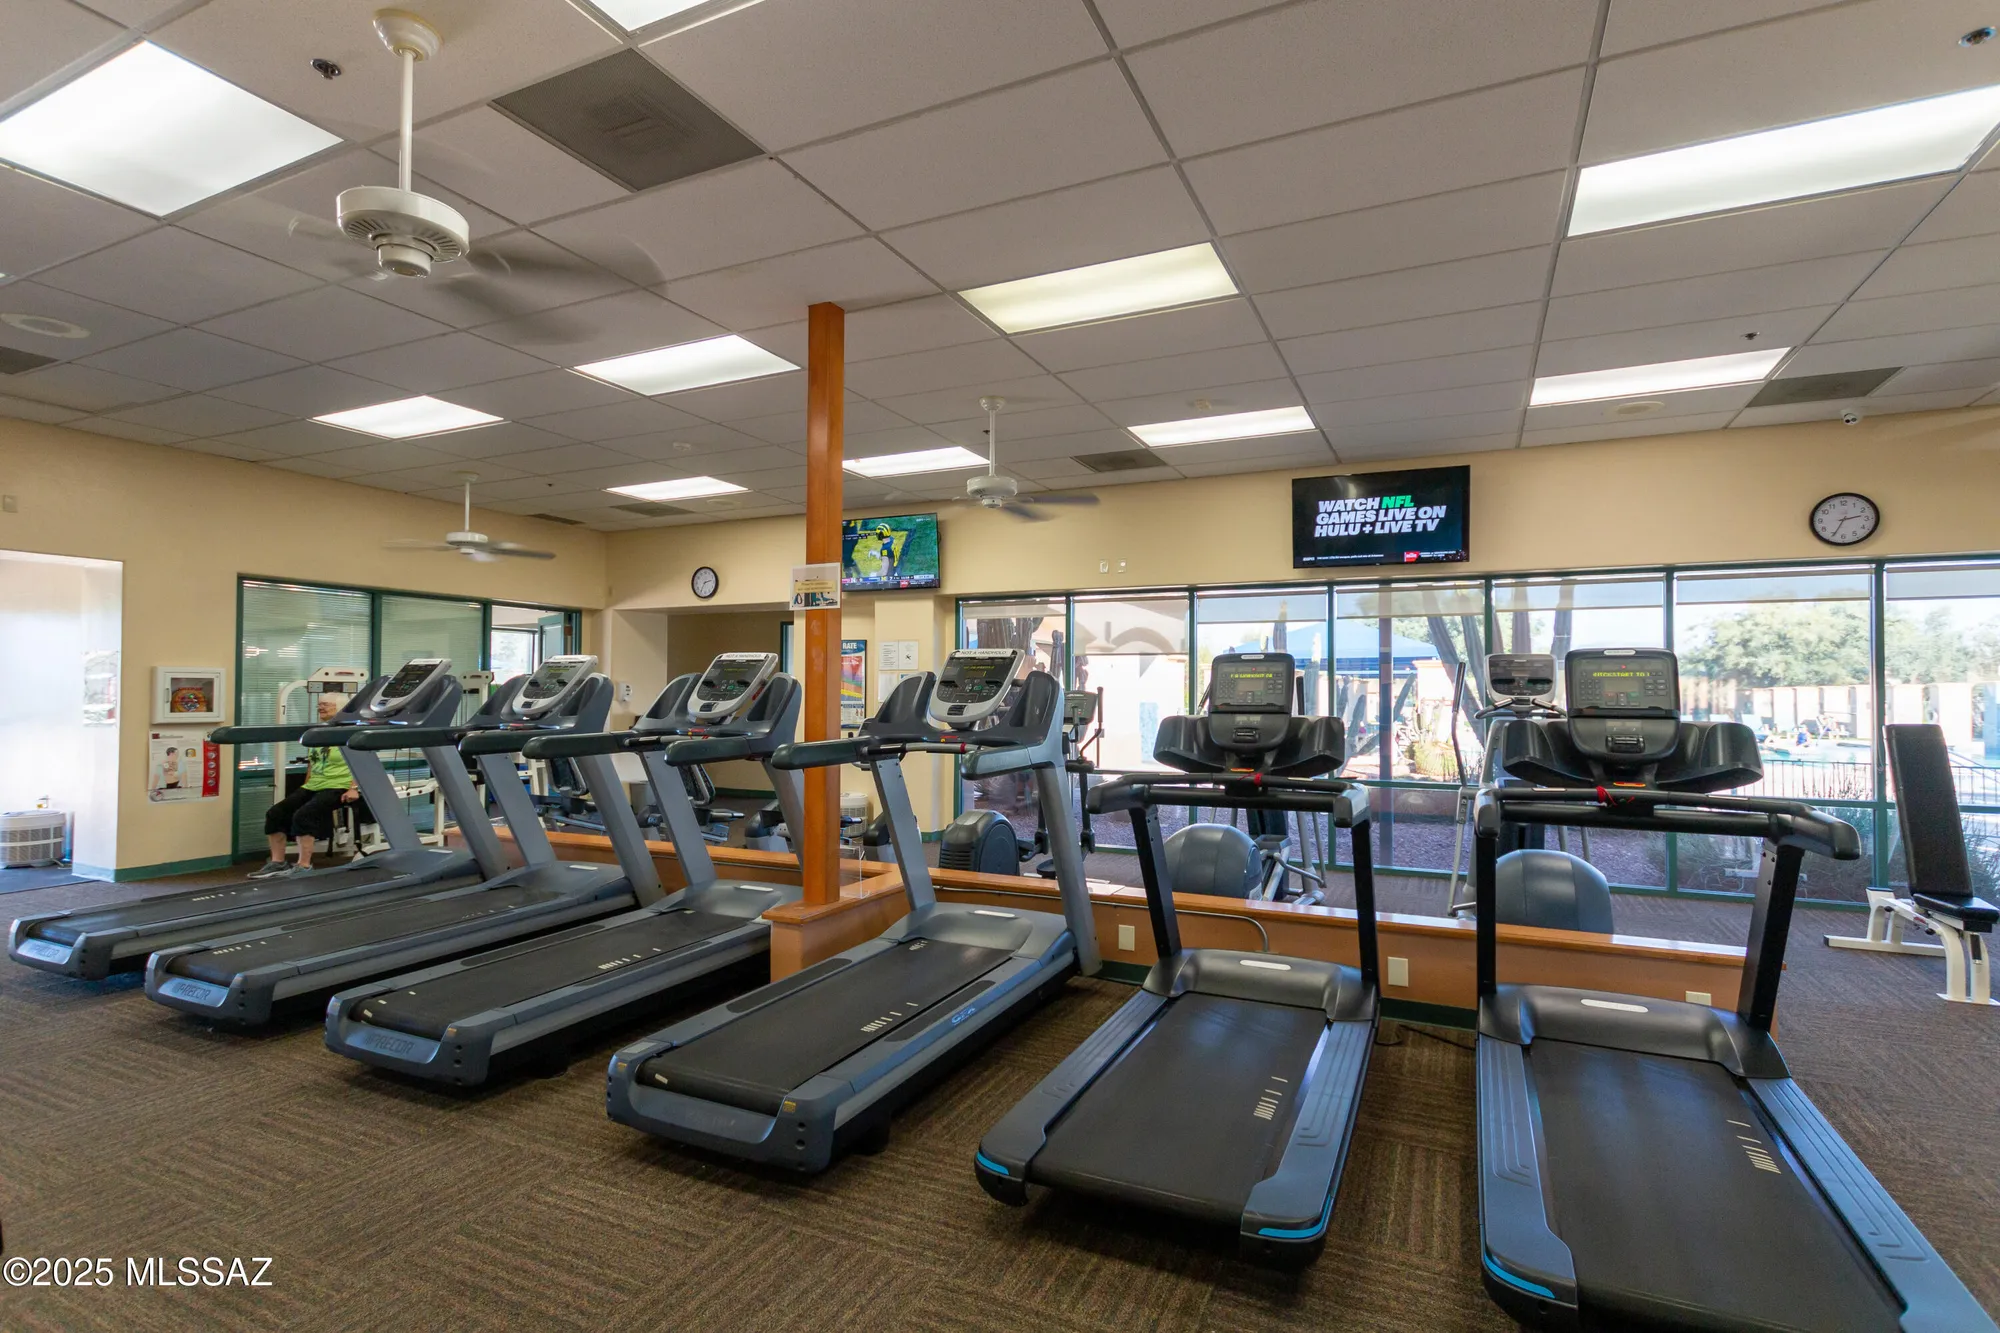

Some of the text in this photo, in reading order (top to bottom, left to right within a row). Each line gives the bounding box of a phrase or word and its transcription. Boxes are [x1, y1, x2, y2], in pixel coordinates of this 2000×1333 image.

[1318, 495, 1415, 513] WATCH NFL
[1316, 505, 1447, 525] GAMES LIVE ON
[1314, 519, 1440, 537] HULU + LIVE TV
[842, 642, 857, 650] RATE
[178, 984, 212, 1000] PRECOR
[370, 1034, 416, 1055] PRECOR
